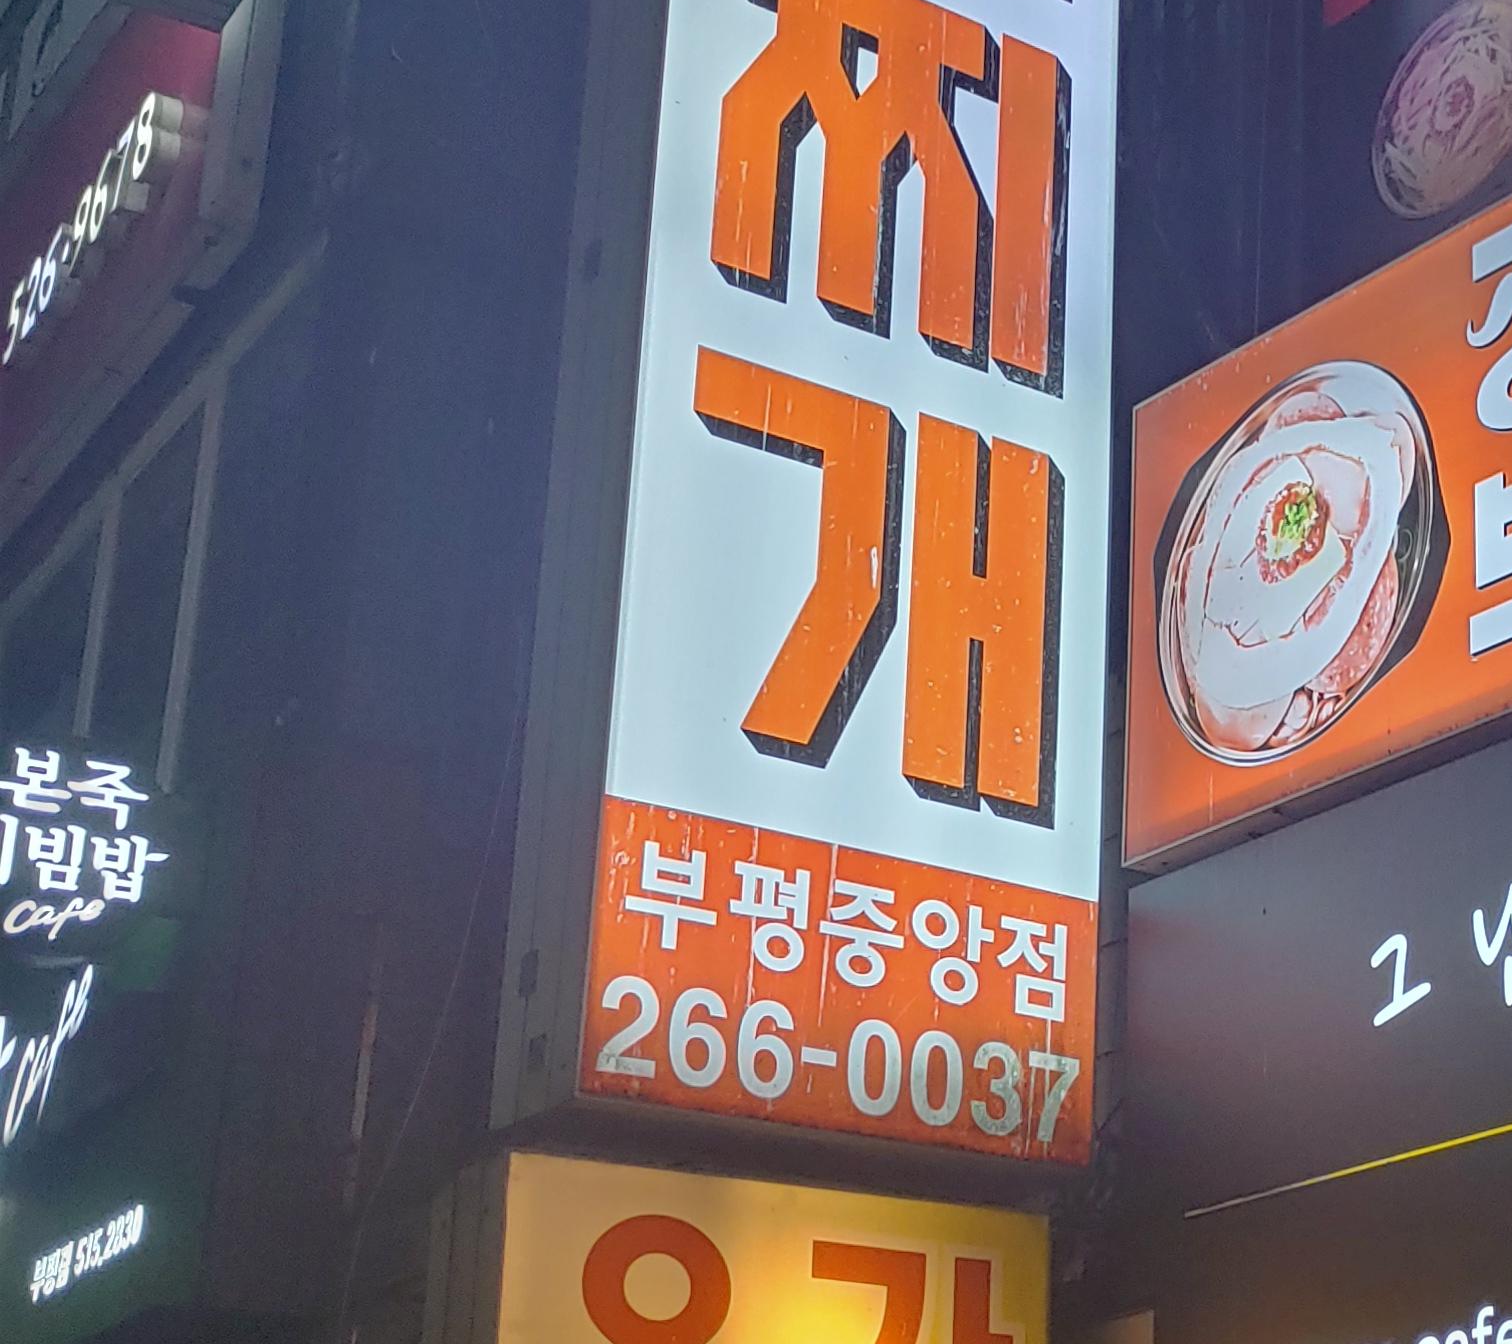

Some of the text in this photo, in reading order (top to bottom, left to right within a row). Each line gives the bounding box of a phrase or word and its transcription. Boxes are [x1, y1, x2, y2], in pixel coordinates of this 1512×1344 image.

[0, 747, 150, 830] 본죽
[624, 840, 1069, 1024] 부평중앙점
[1371, 934, 1431, 1028] 그
[595, 974, 1081, 1143] 266-0037
